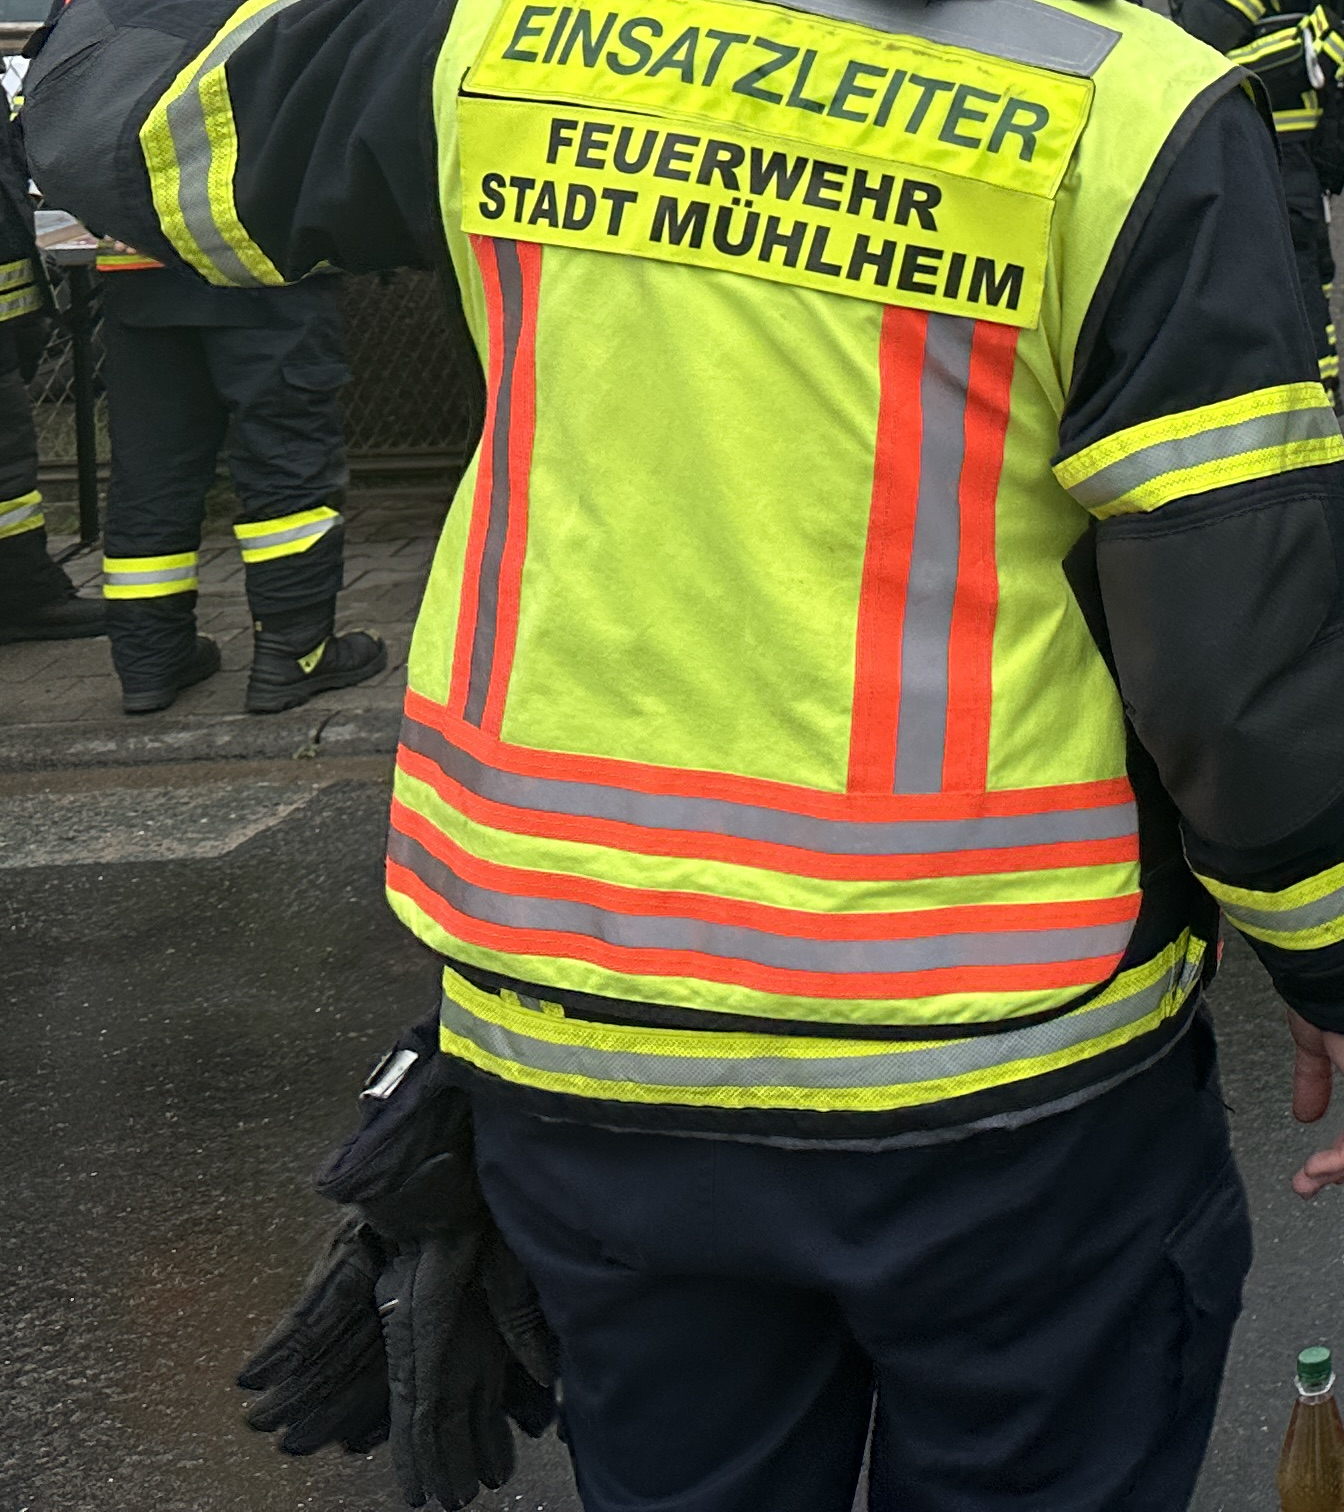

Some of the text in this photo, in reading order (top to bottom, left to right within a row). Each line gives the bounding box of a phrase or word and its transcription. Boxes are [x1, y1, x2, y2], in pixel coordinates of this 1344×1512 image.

[502, 3, 1051, 163] EINSATZLEITER
[478, 171, 1026, 311] STADT MÜHLHEIM
[546, 117, 943, 232] FEUERWEHR
